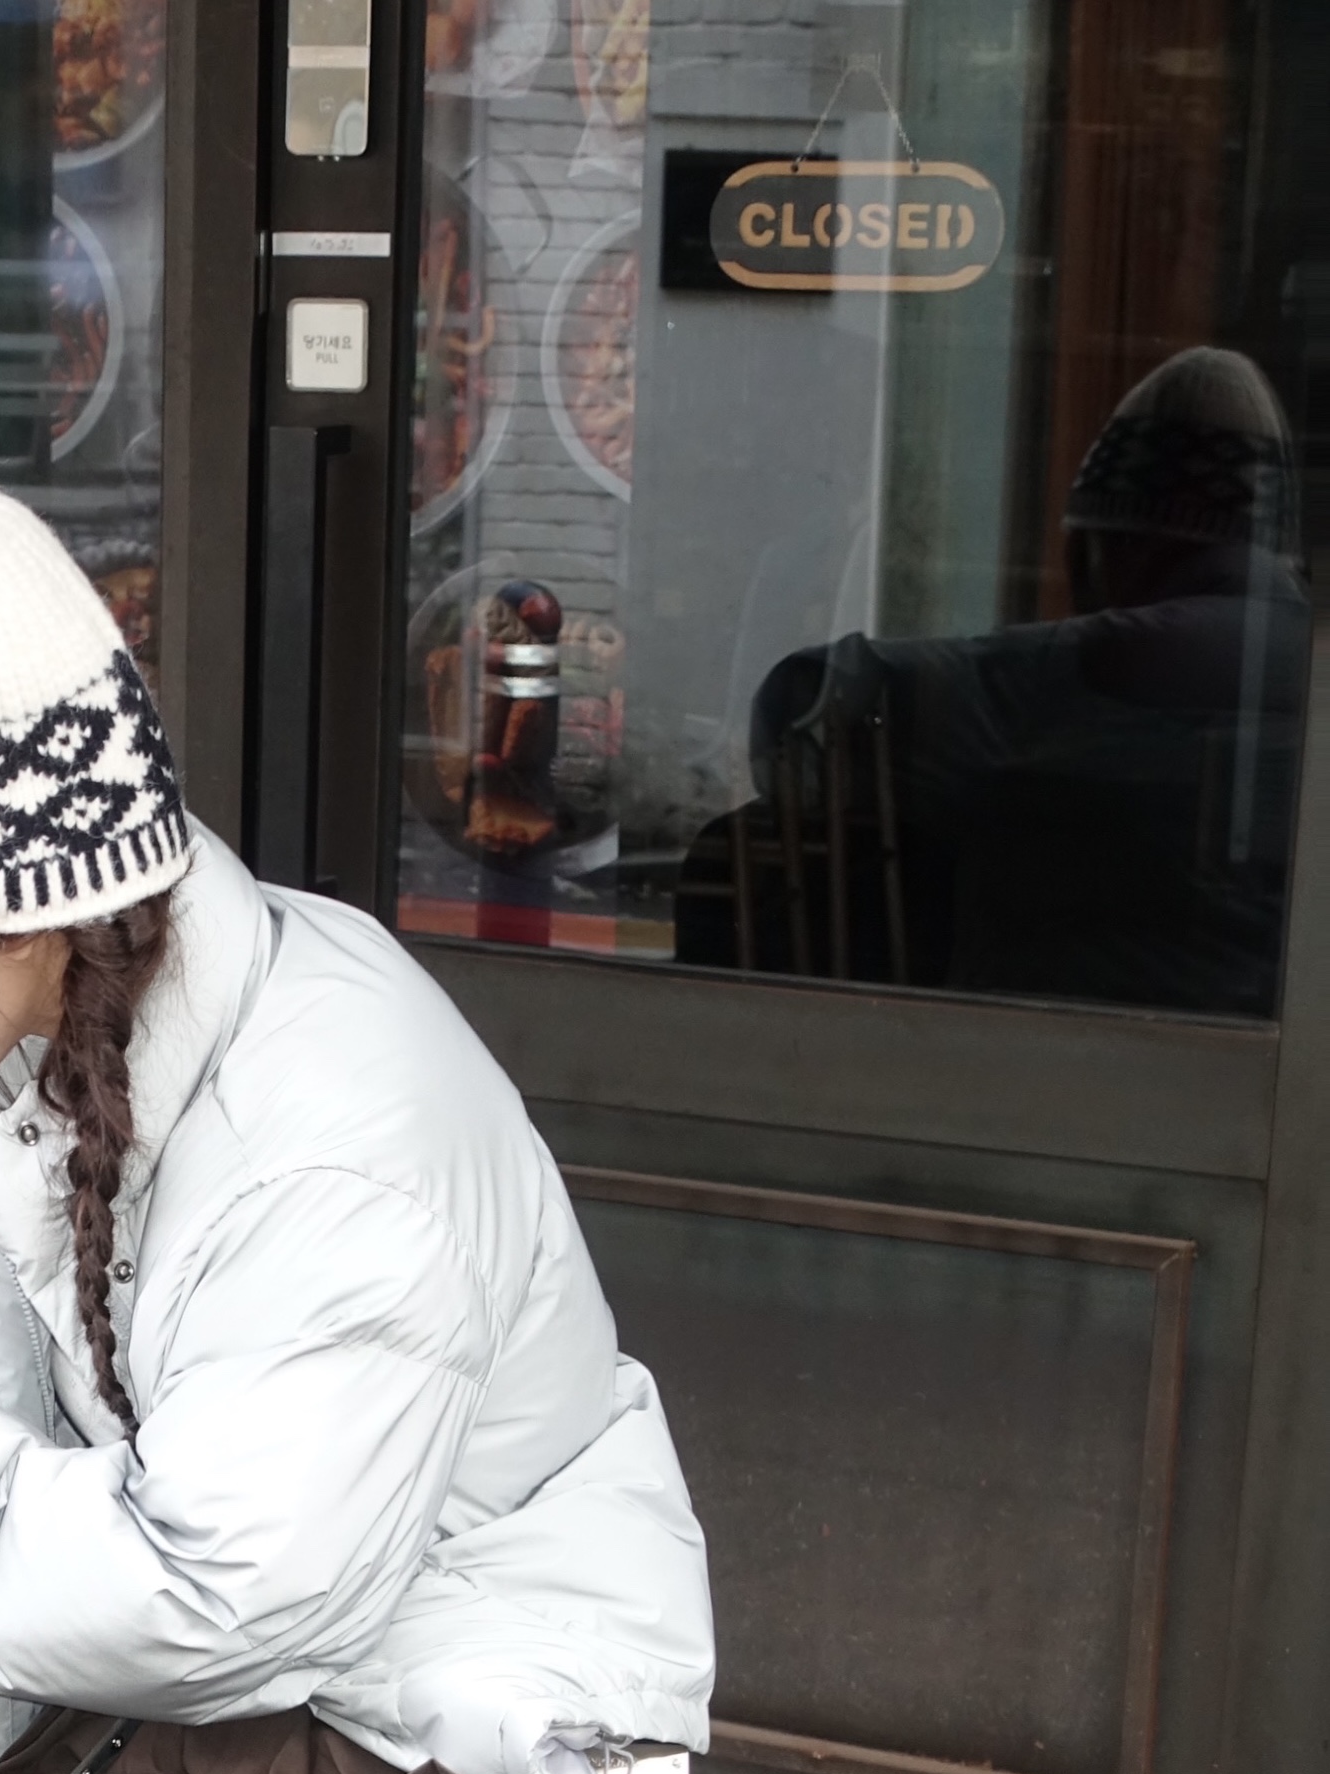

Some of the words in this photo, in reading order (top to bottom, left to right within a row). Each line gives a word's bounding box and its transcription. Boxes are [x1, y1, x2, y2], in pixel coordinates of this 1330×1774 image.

[738, 202, 975, 249] CLOSED
[302, 335, 352, 350] 당기세요
[315, 352, 339, 364] PULL
